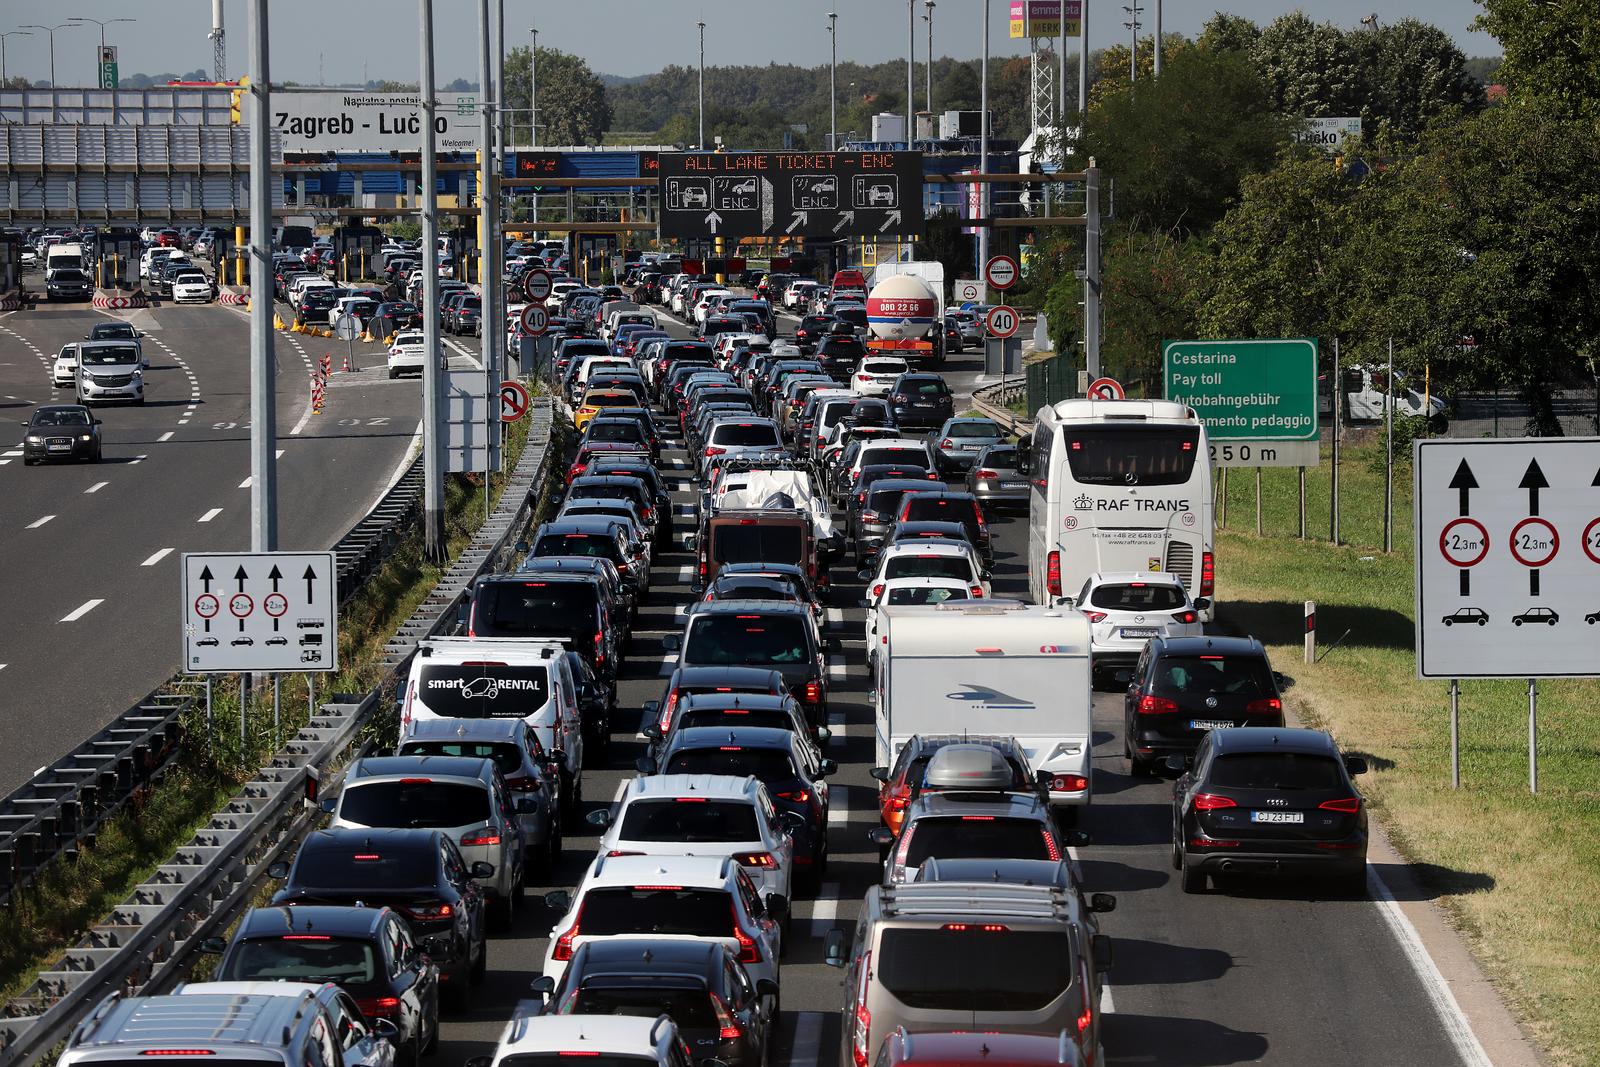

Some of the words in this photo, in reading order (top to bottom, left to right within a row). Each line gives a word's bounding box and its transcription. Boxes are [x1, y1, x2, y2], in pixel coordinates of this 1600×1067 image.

[1032, 5, 1079, 15] emmeeta
[1034, 23, 1077, 33] MERKRY
[275, 113, 354, 139] Zagreb
[379, 112, 448, 134] Lučo
[441, 139, 474, 147] Welcome!
[685, 156, 718, 170] ALL
[725, 156, 768, 170] LANE
[776, 154, 836, 169] TICKET
[862, 154, 894, 168] ENC
[722, 197, 750, 209] ENC
[801, 196, 829, 208] ENC
[880, 303, 895, 311] 080
[897, 303, 908, 311] 22
[909, 303, 919, 311] 66
[528, 312, 545, 327] 40
[994, 314, 1012, 330] 40
[1172, 352, 1236, 364] Cestarina
[1172, 373, 1197, 387] Pay
[1201, 372, 1222, 385] toll
[1174, 393, 1281, 408] Autobahngebühr
[1252, 414, 1311, 429] pedaggio
[1261, 448, 1277, 461] m
[1097, 499, 1129, 511] RAF
[1134, 499, 1190, 511] TRANS
[1066, 519, 1076, 527] 80
[428, 678, 465, 689] smart
[498, 679, 540, 691] RENTAL
[1258, 812, 1269, 821] CJ
[1272, 812, 1283, 821] 23
[1285, 813, 1302, 822] FTJ
